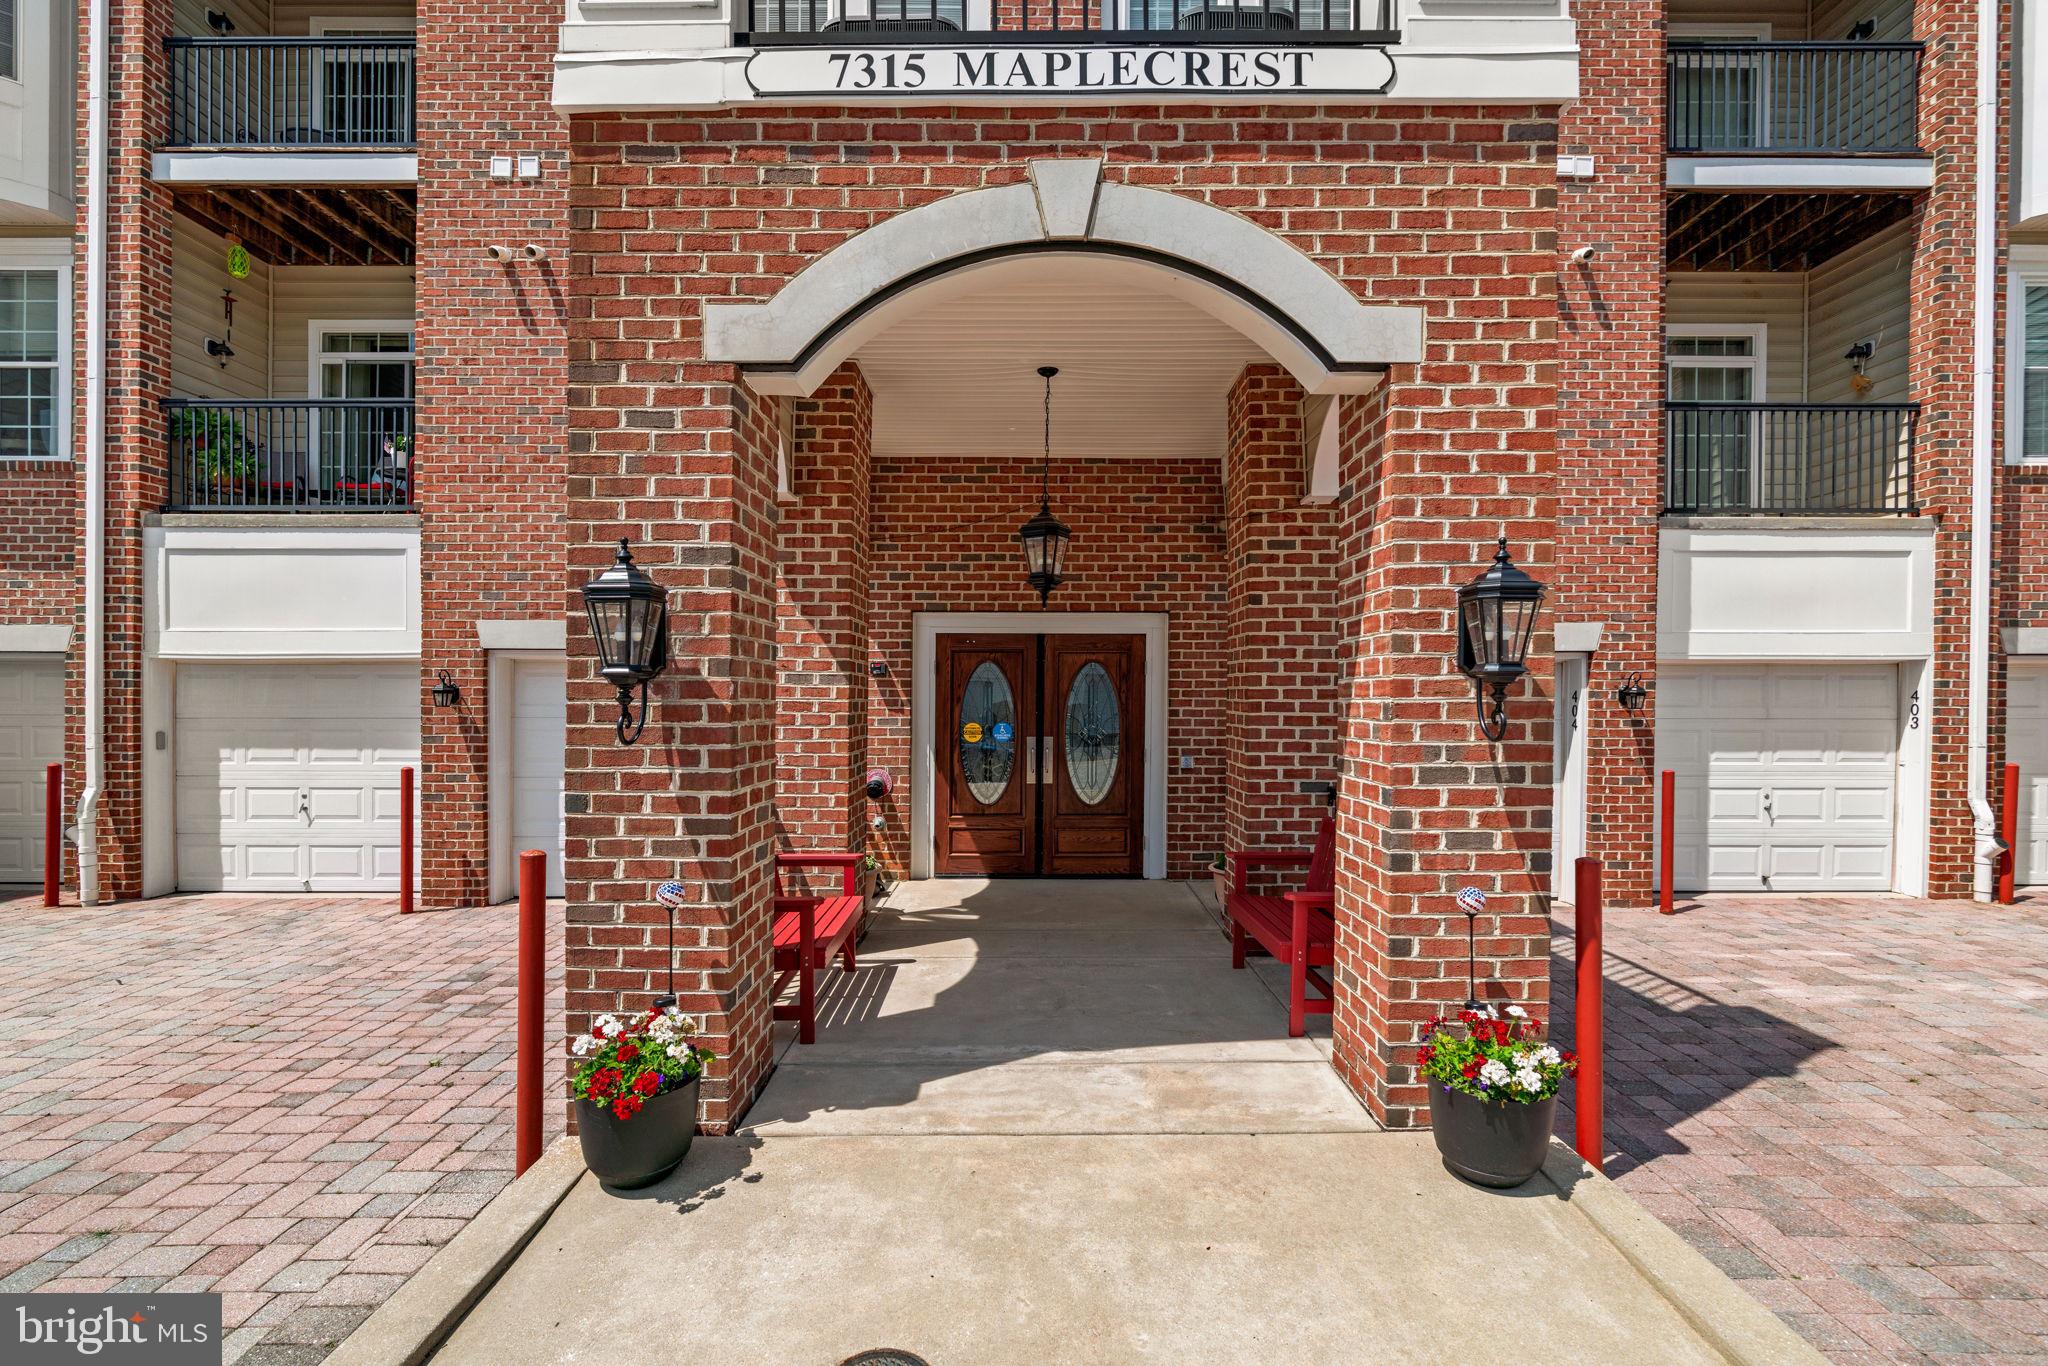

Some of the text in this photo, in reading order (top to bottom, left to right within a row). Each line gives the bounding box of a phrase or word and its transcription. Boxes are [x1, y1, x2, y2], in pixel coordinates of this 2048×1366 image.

[828, 51, 1314, 88] 7315 MAPLECREST
[1910, 690, 1919, 729] 403
